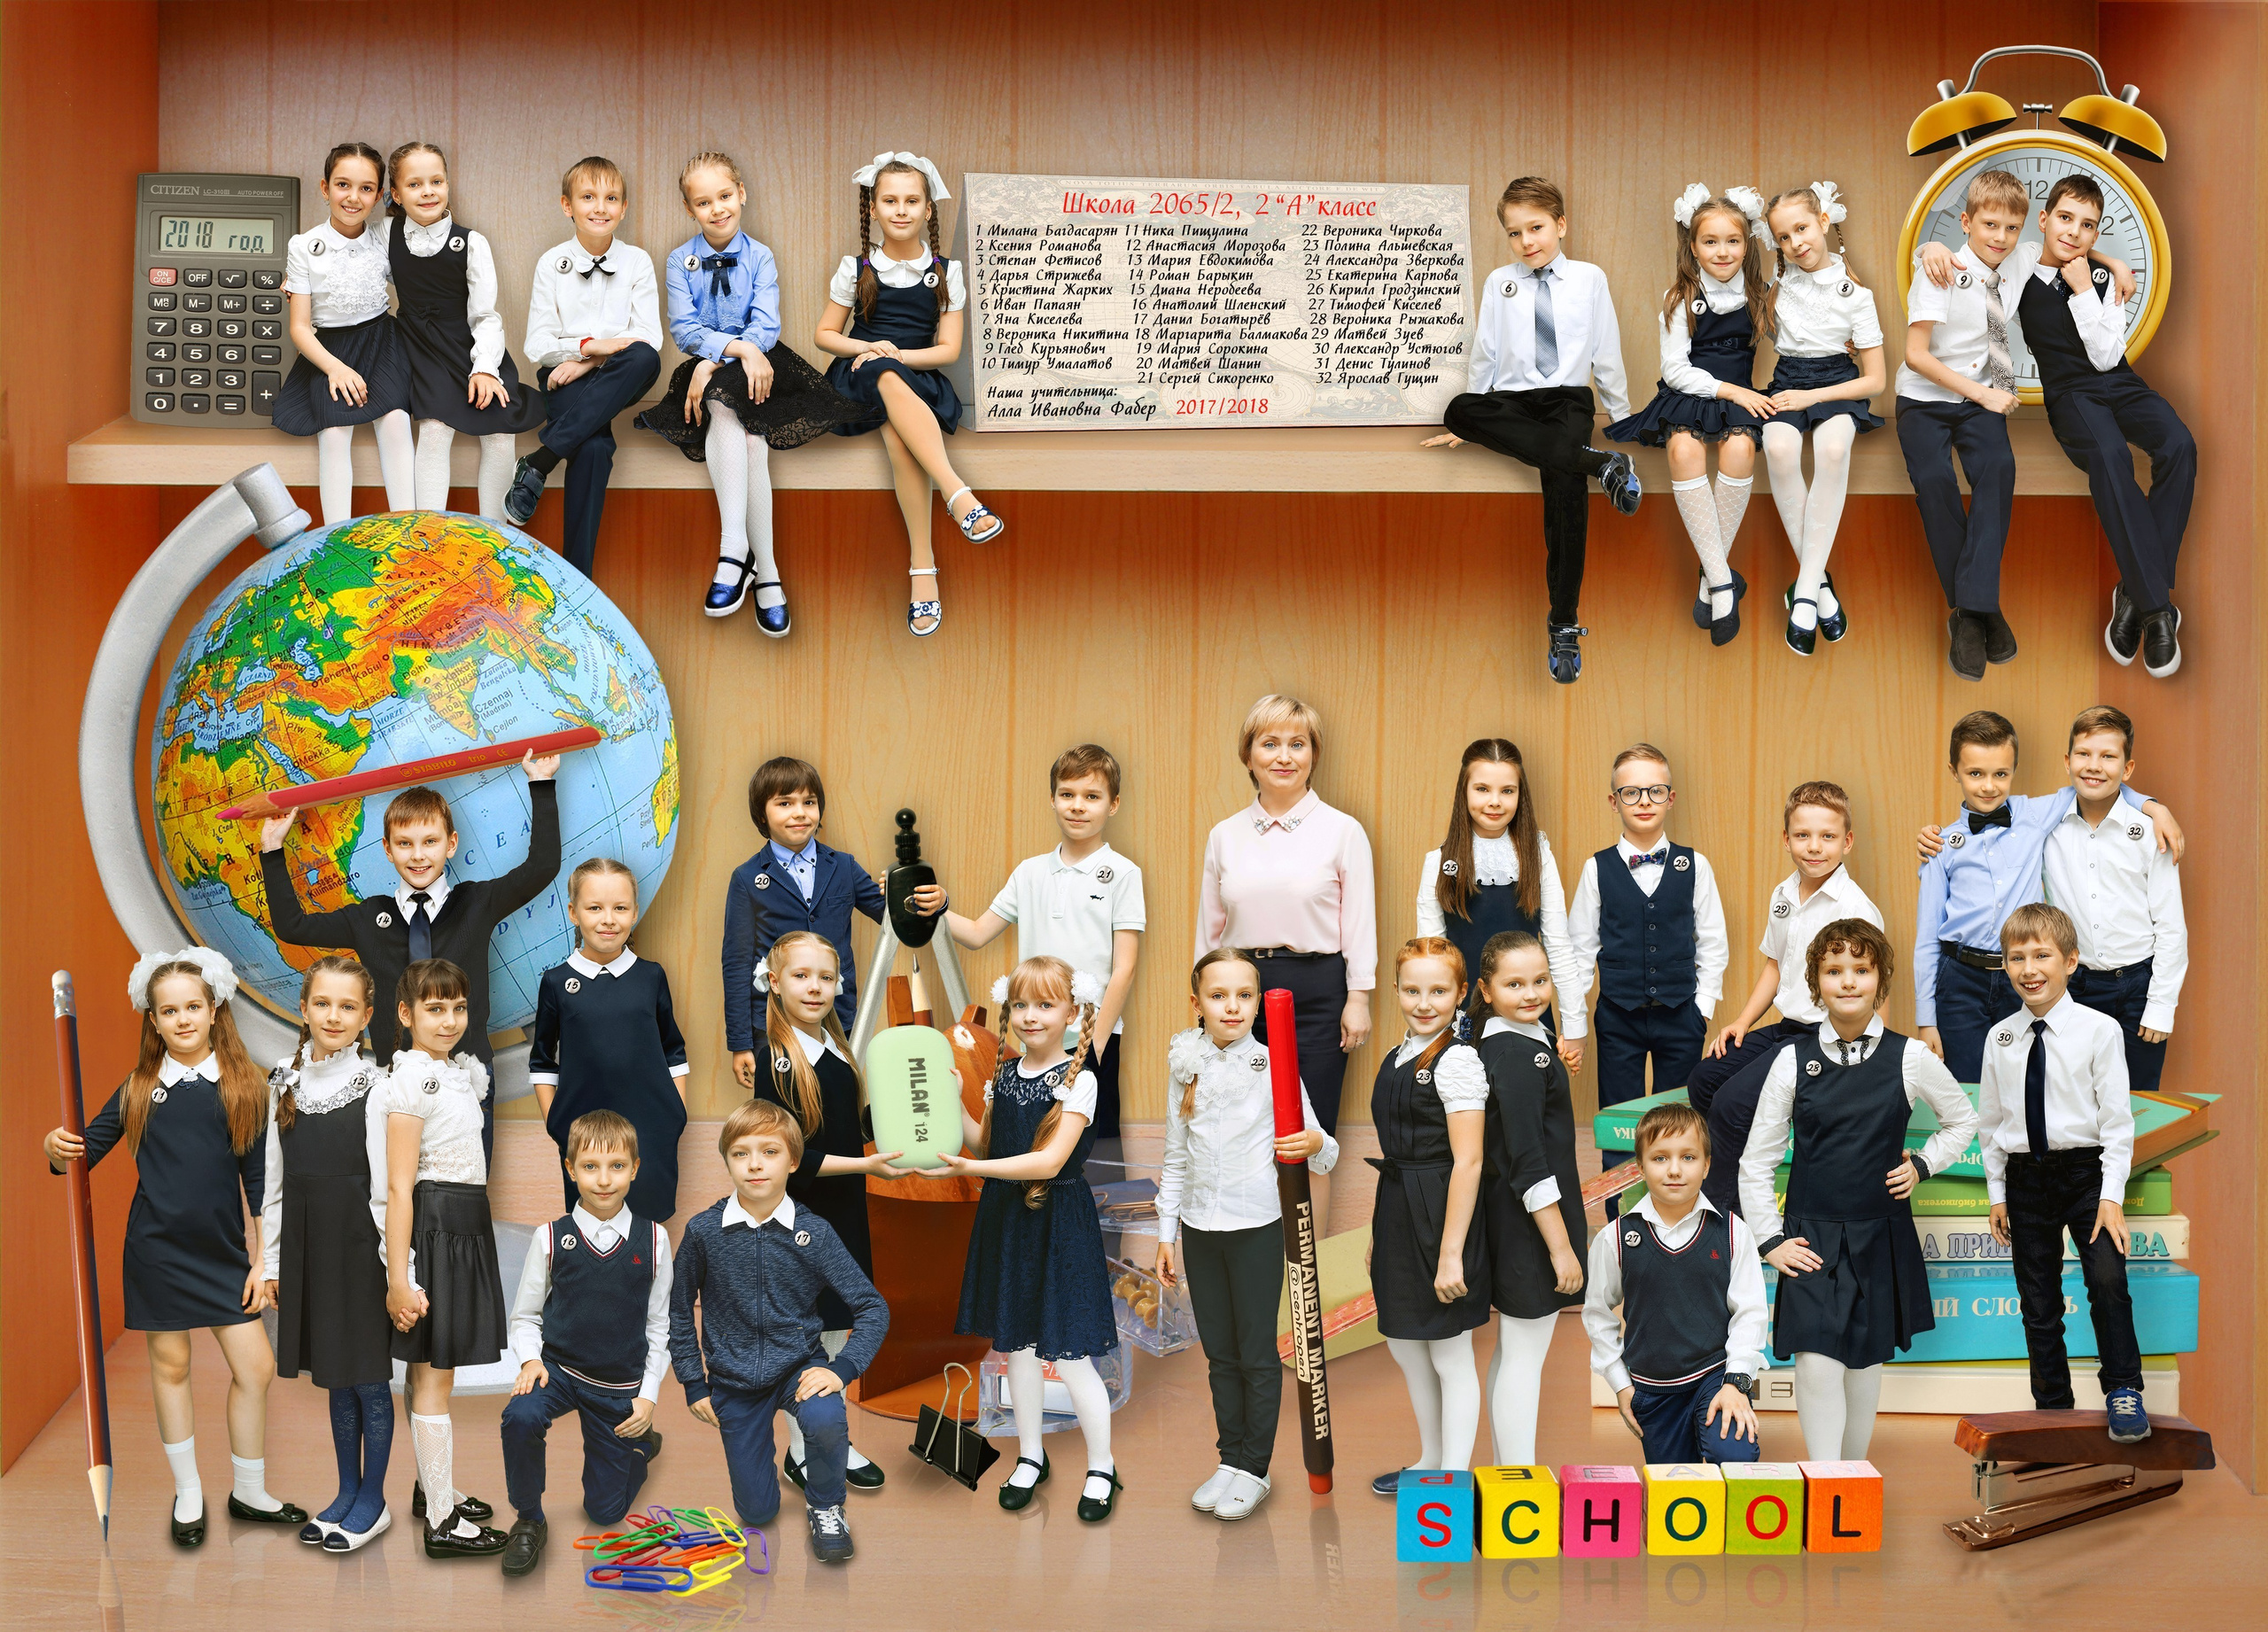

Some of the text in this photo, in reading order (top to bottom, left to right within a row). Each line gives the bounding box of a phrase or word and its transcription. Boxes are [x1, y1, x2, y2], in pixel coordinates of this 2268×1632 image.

[151, 184, 200, 196] CITIZEN
[2025, 180, 2048, 200] 12
[1063, 191, 1135, 214] Школа
[1149, 191, 1241, 220] 2065/2,
[1255, 193, 1270, 214] 2
[1317, 199, 1376, 216] класс
[988, 224, 1117, 241] Милана Багдасарян
[1143, 224, 1247, 241] Ника Пищулина
[1324, 224, 1441, 241] Вероника Чиркова
[2101, 215, 2115, 236] 2
[165, 220, 214, 249] 2018
[990, 239, 1100, 251] Ксения Романова
[1146, 239, 1285, 255] Анастасия Морозова
[1325, 239, 1453, 251] Полина Альшевская
[990, 253, 1102, 266] Степан Фетисов
[1148, 253, 1273, 270] Мария Евдокимова
[1326, 253, 1464, 270] Александра Зверкова
[990, 268, 1101, 284] Дарья Стрижева
[1150, 268, 1253, 284] Роман Барыкин
[1328, 268, 1457, 284] Екатерина Карпова
[992, 284, 1113, 299] Кристина Жарких
[1151, 282, 1261, 299] Диана Неробеева
[1330, 284, 1461, 299] Кирилл Гродзинский
[994, 298, 1080, 310] Иван Папаян
[1153, 298, 1286, 310] Анатолий Шленский
[1331, 296, 1441, 315] Тимофей Киселев
[995, 313, 1082, 324] Яна Киселева
[1153, 313, 1192, 326] Данил
[1333, 313, 1464, 329] Вероника Рыжакова
[997, 328, 1128, 344] Вероника Никитина
[1156, 328, 1307, 344] Маргарита Балмакова
[1334, 328, 1424, 344] Матвей Зуев
[998, 340, 1105, 359] Глеб Курьянович
[1157, 342, 1267, 359] Мария Сорокина
[1335, 342, 1463, 359] Александр Устюгов
[1001, 357, 1112, 373] Тимур Умалатов
[1158, 357, 1261, 369] Матвей Шанин
[1336, 357, 1431, 373] Денис Тулинов
[1160, 372, 1273, 388] Сергей Сикоренко
[1338, 372, 1438, 388] Ярослав Гущин
[988, 386, 1118, 403] Наша учительница:
[988, 398, 1156, 421] Алла Ивановна Фабер
[1176, 398, 1269, 416] 2017/2018
[429, 613, 469, 640] TYBET
[354, 662, 383, 681] Kabul
[403, 664, 428, 680] Delhi
[352, 688, 390, 711] Karaczi
[474, 688, 515, 714] Czennaj
[423, 701, 463, 725] Mumbaj
[481, 700, 512, 722] (Madras)
[493, 715, 519, 734] Cejlon
[236, 742, 252, 753] Kair
[300, 747, 330, 766] Mekka
[413, 754, 486, 774] STABILO trio
[566, 981, 579, 990] 15
[1999, 1033, 2012, 1042] 30
[1535, 1056, 1549, 1065] 24
[1296, 1201, 1330, 1441] PERMANENT MARKER
[1292, 1288, 1307, 1377] centropen
